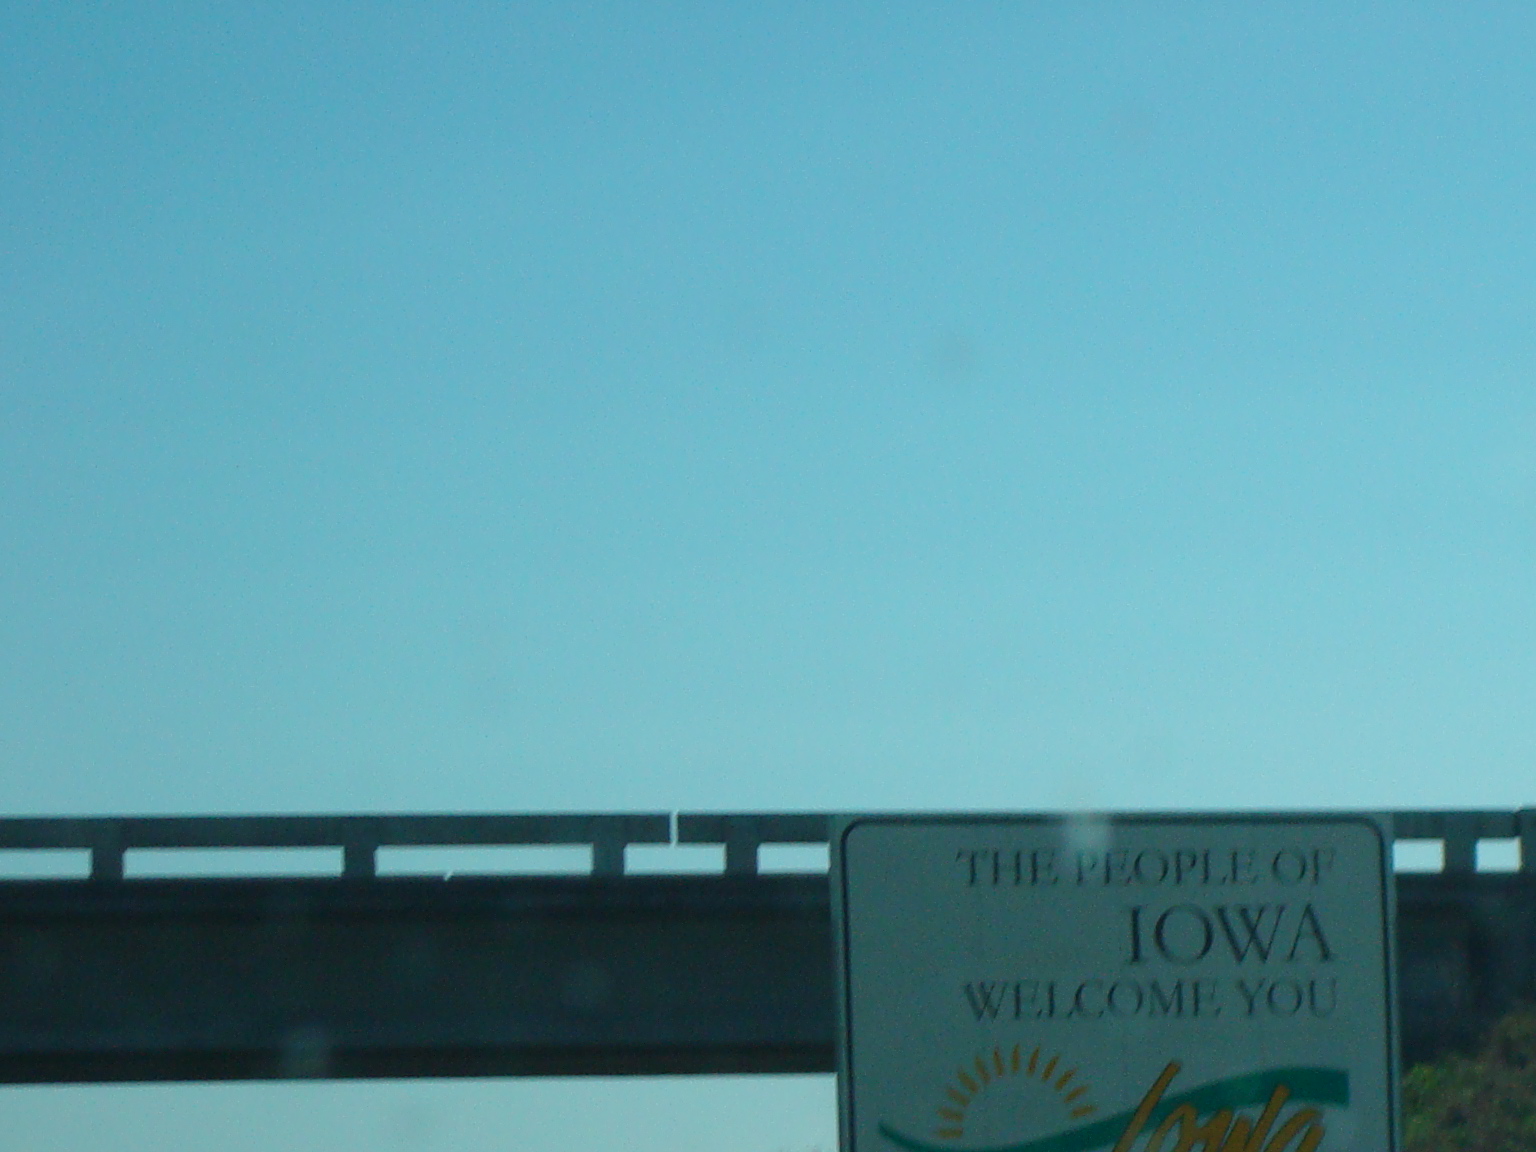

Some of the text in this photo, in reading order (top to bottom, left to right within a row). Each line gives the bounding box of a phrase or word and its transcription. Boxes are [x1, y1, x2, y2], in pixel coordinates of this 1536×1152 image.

[955, 846, 1337, 889] THE PEOPLE OF
[1126, 903, 1335, 965] IOWA
[963, 977, 1338, 1021] WELCOME YOU
